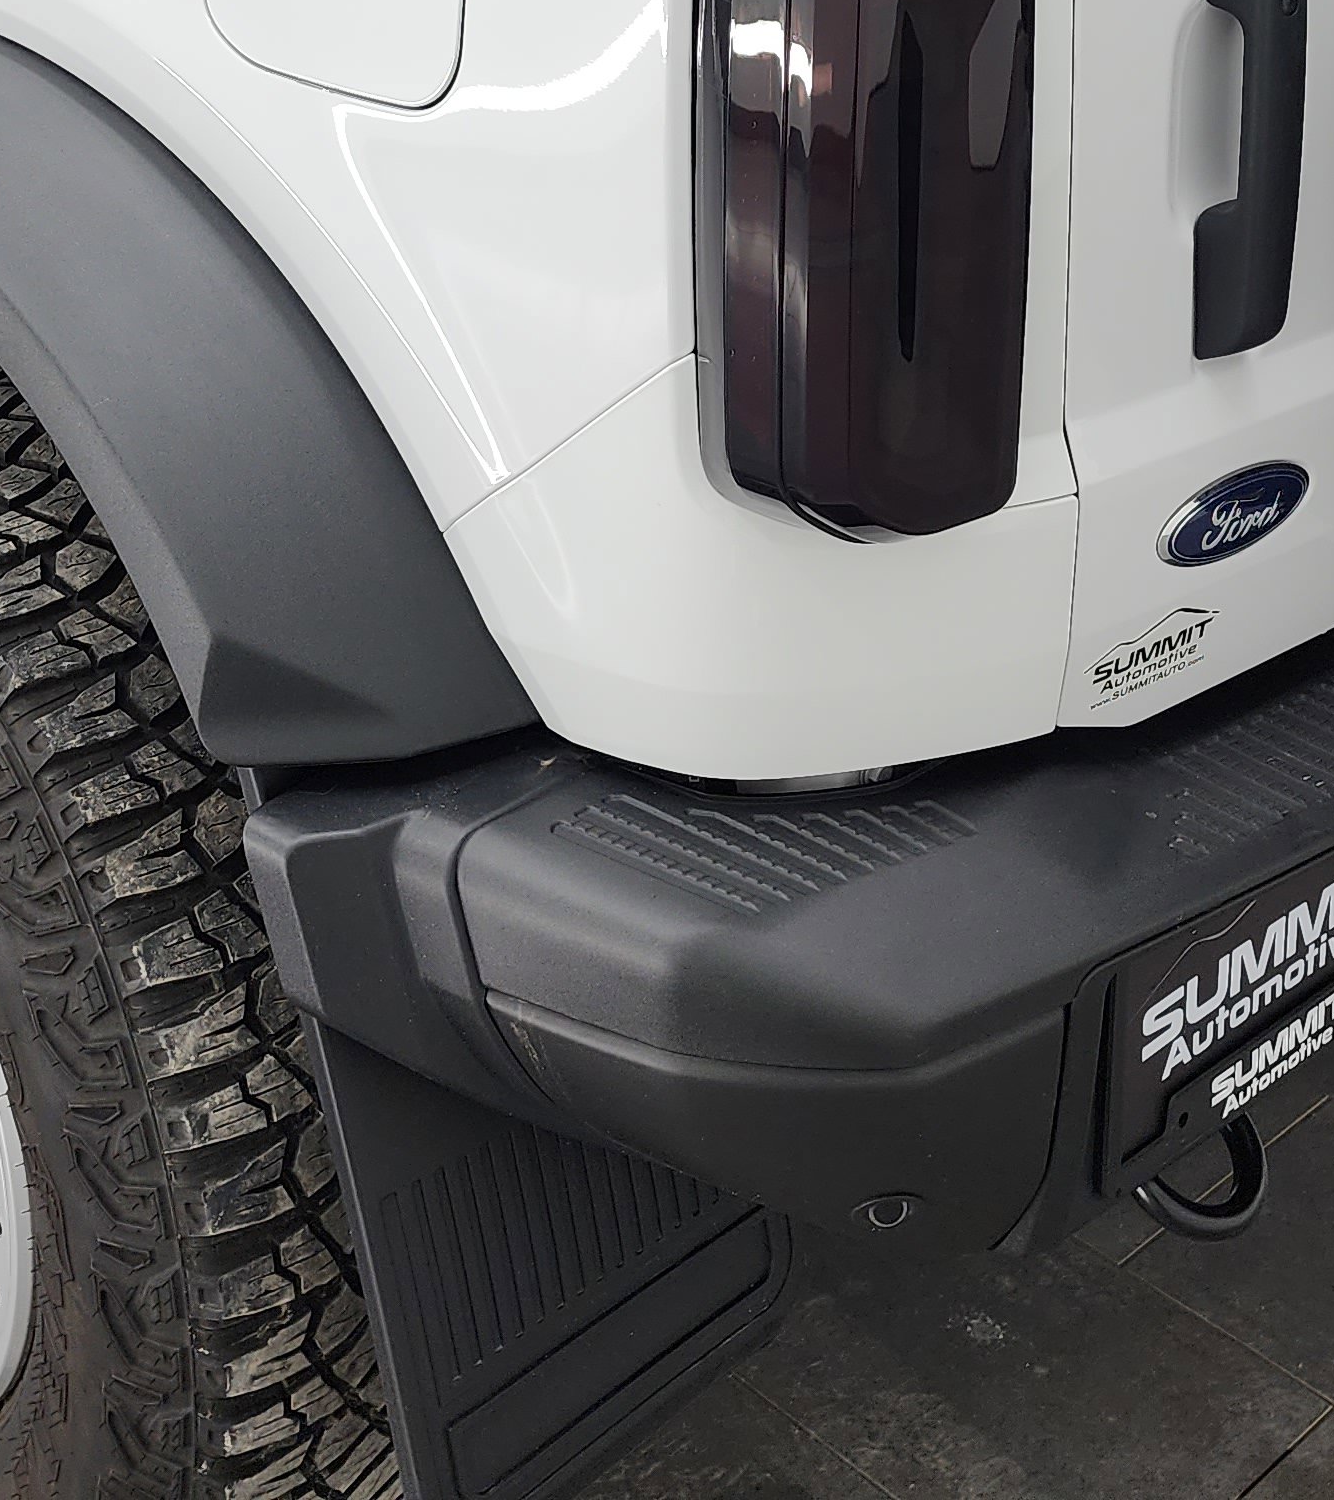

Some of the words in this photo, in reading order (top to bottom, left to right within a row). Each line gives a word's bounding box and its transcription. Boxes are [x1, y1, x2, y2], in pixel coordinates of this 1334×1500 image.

[1200, 486, 1283, 551] Ford
[1092, 616, 1214, 685] SUMMIT
[1100, 644, 1197, 694] Automotive
[1222, 1026, 1334, 1120] Automotive
